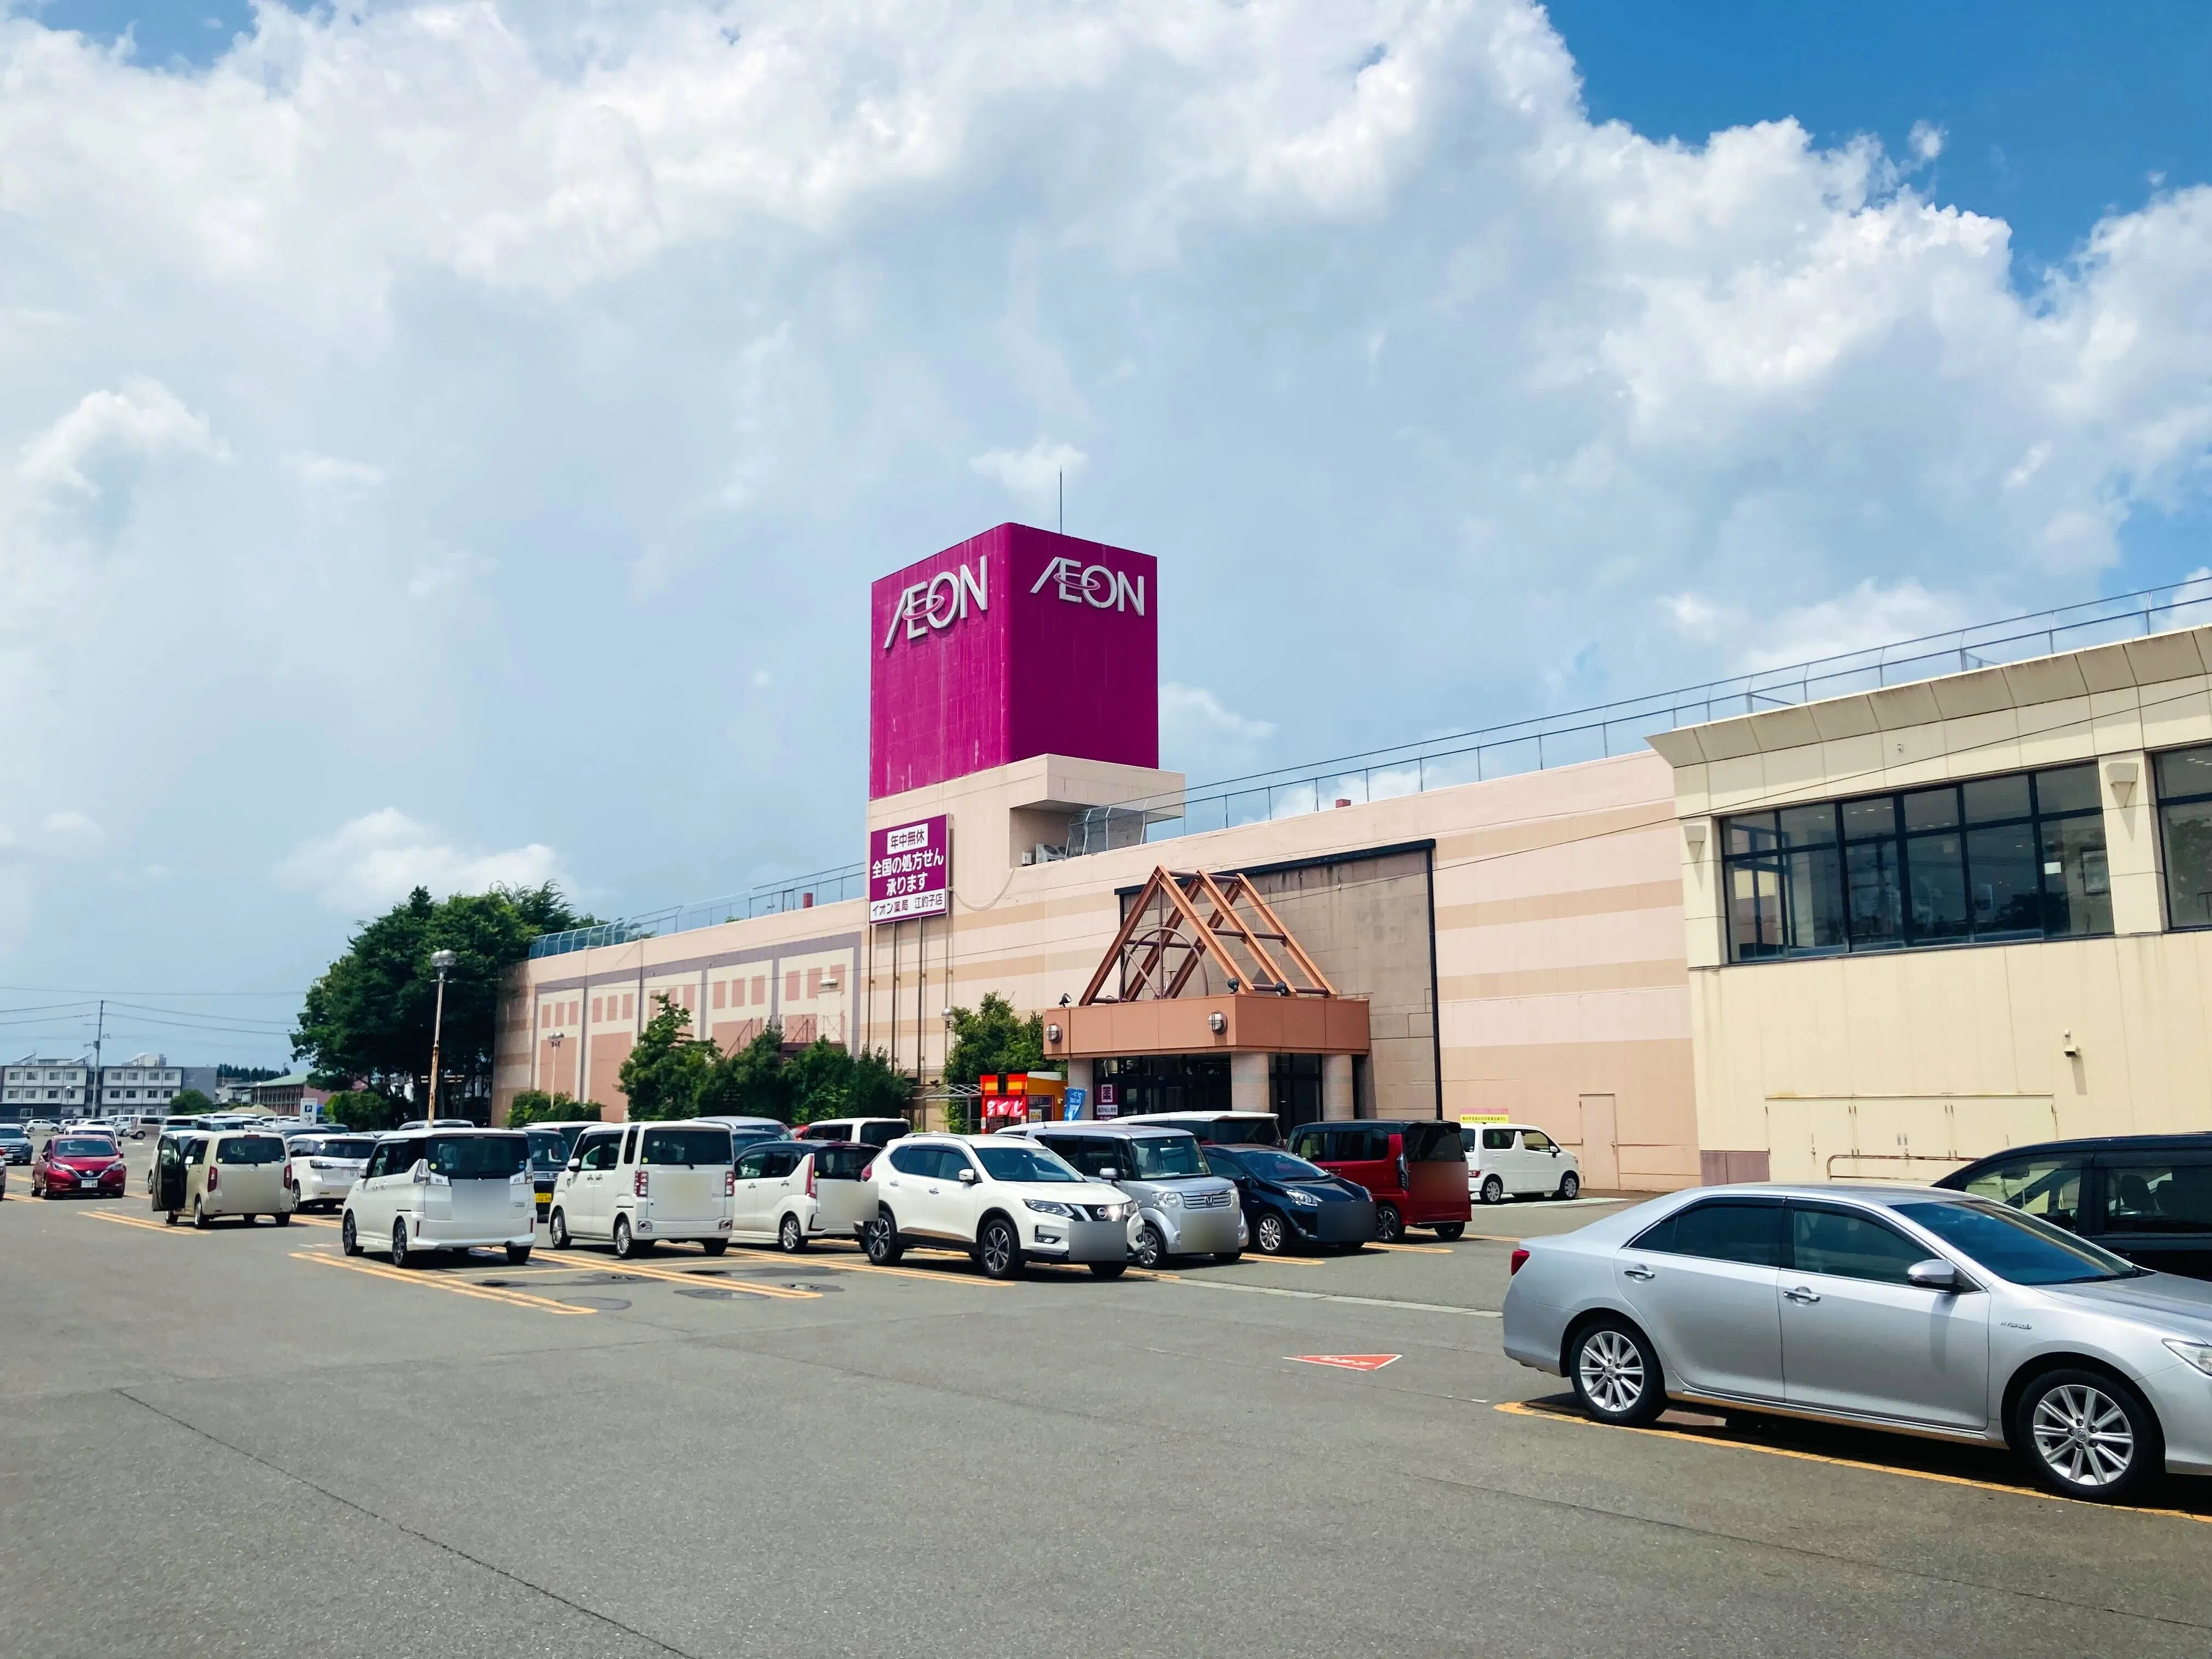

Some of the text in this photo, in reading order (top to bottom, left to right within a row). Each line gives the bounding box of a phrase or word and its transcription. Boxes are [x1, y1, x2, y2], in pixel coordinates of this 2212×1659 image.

[890, 829, 924, 849] 年中無休
[872, 848, 944, 879] 全国の処方せん
[886, 871, 928, 896] 承ります
[872, 893, 943, 916] イオン薬局 江釣子店
